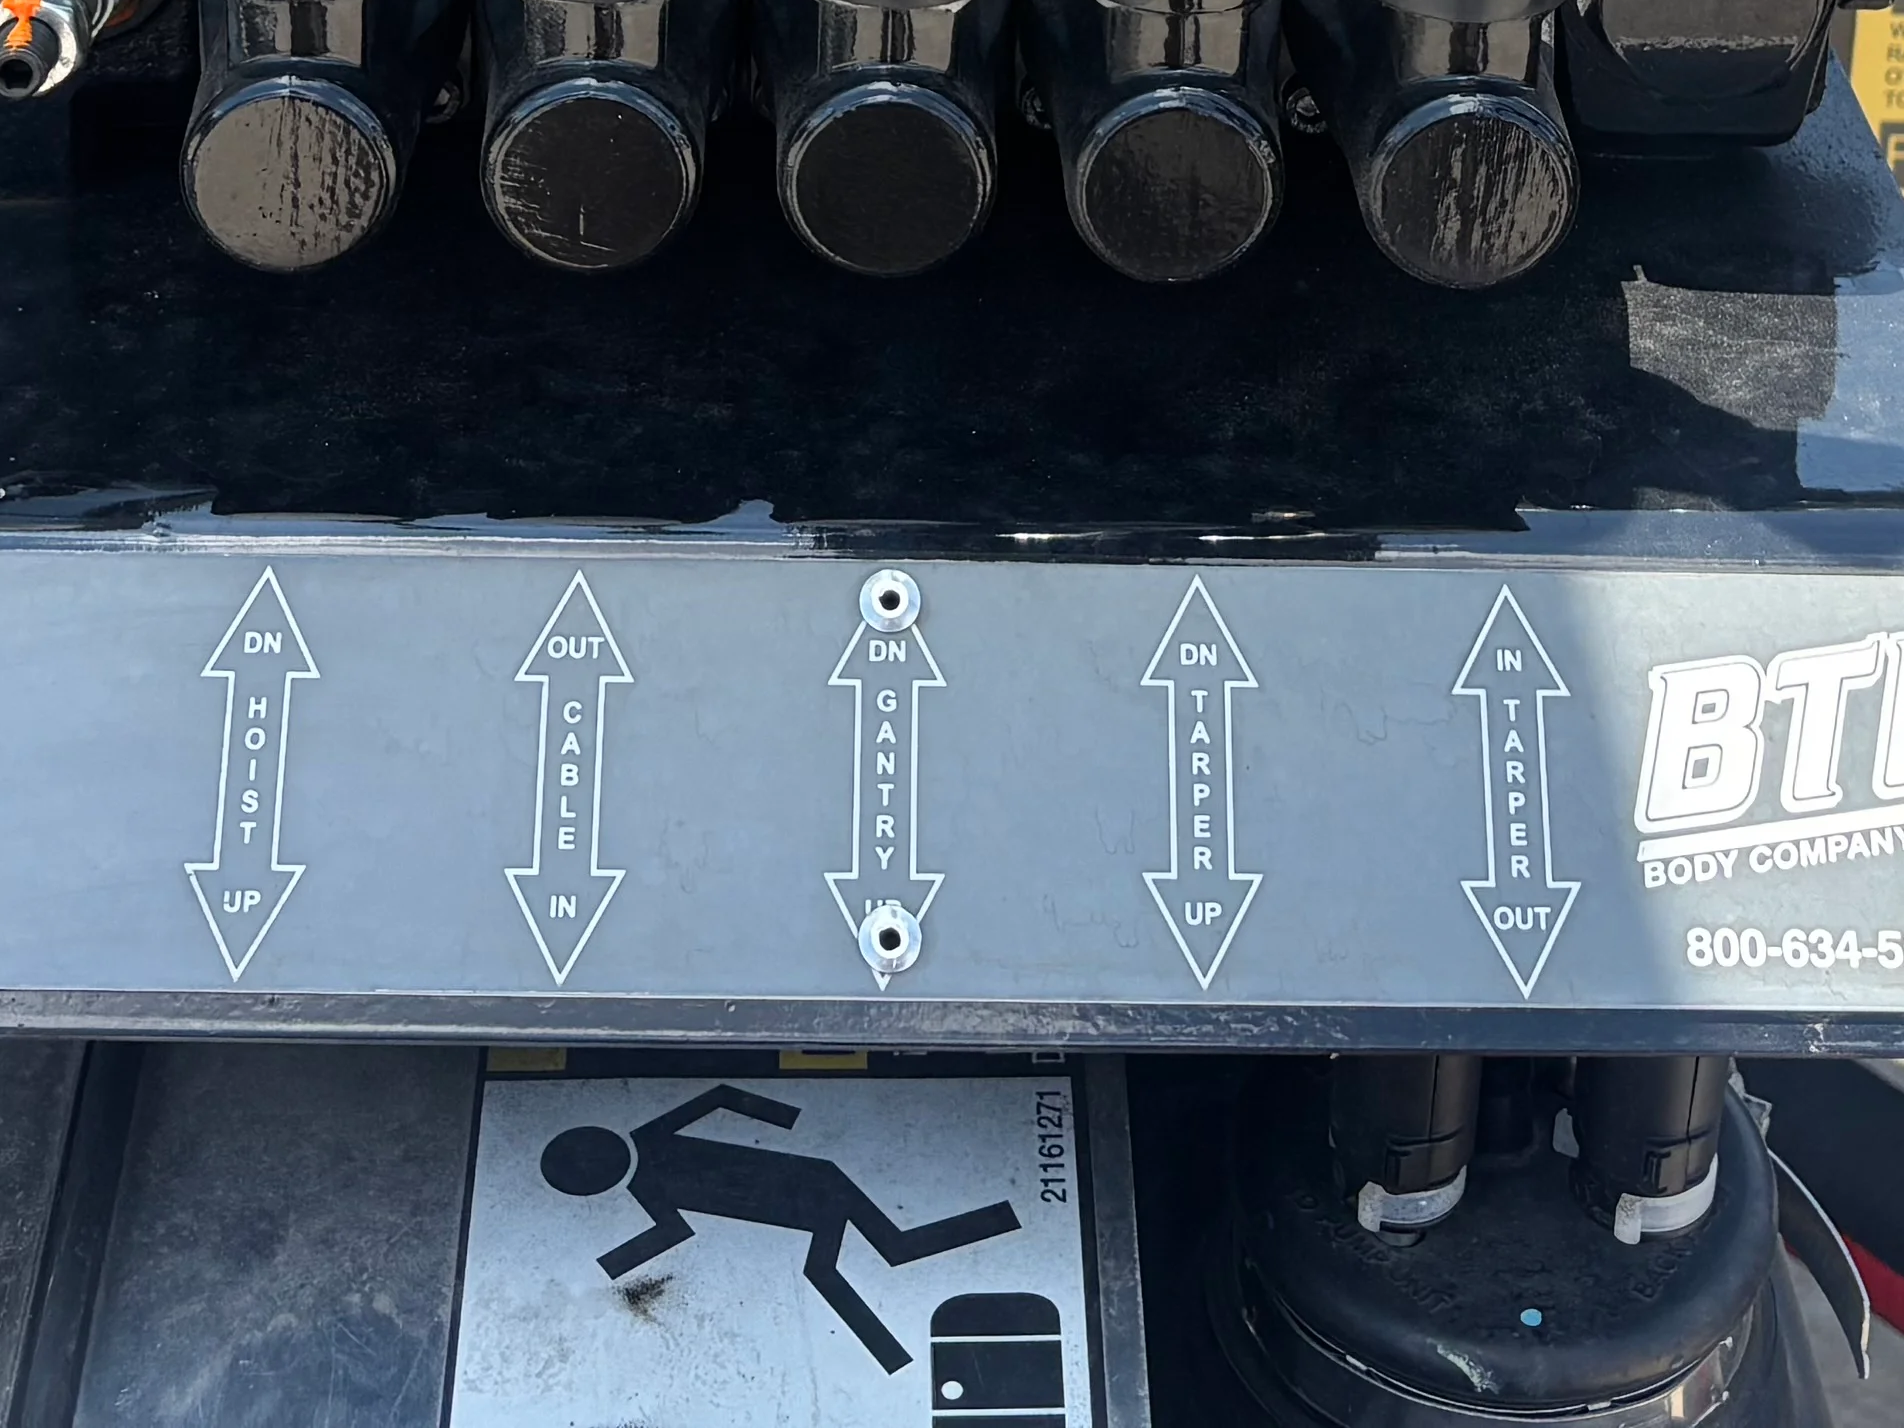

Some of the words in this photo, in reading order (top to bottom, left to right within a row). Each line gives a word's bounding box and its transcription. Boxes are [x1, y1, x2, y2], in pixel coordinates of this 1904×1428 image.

[244, 631, 283, 654] DN
[547, 636, 605, 659] OUT
[869, 640, 907, 662] DN
[1180, 643, 1218, 666] DN
[1496, 649, 1522, 672] IN
[239, 697, 267, 844] HOIST
[557, 700, 583, 850] CABLE
[875, 689, 898, 870] GANTRY
[1190, 690, 1213, 870] TARPER
[1503, 699, 1531, 879] TARPER
[1644, 849, 1738, 888] BODY
[222, 890, 261, 913] UP
[549, 895, 577, 919] IN
[1184, 902, 1223, 925] UP
[1494, 906, 1552, 931] OUT
[1039, 1089, 1067, 1204] 21161271
